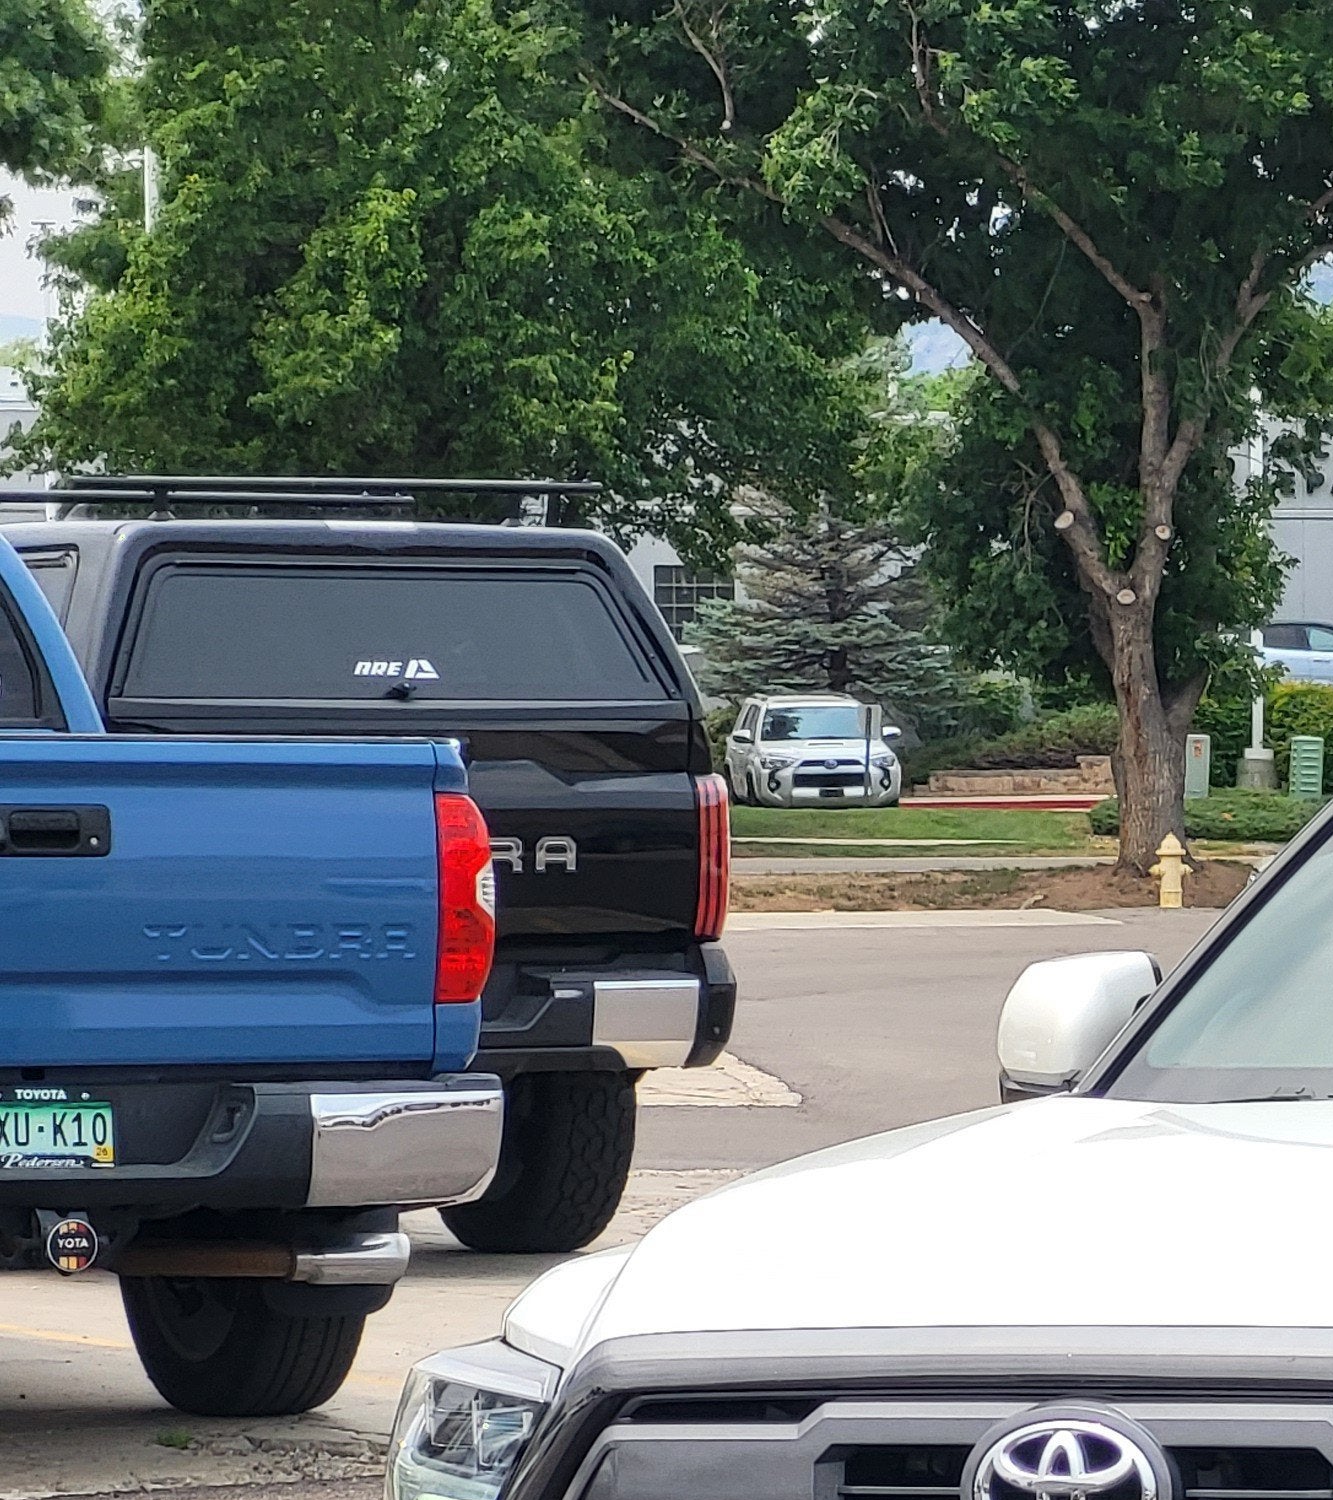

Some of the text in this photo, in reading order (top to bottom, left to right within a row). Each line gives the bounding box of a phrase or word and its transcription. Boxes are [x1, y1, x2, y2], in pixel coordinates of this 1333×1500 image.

[143, 922, 416, 960] TUNDRA
[14, 1088, 67, 1100] TOYOTA
[57, 1237, 89, 1248] YOTA
